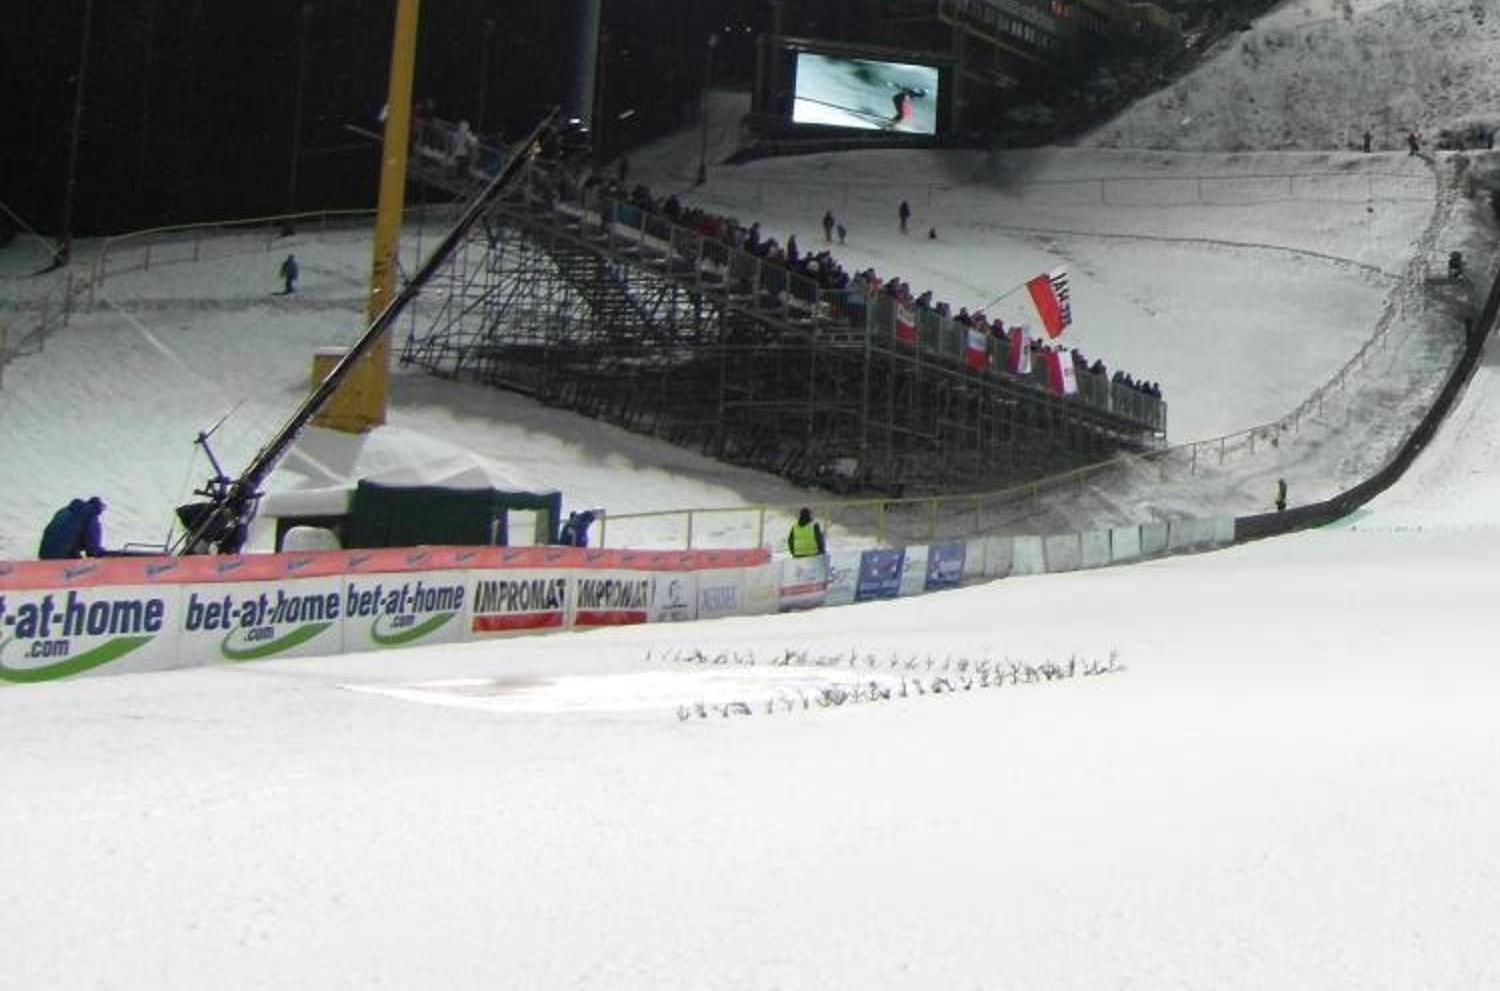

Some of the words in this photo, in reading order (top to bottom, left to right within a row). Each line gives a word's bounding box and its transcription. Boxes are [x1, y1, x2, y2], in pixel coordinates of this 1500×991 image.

[346, 581, 465, 618] bet-at-home
[474, 578, 566, 612] IMPROMAT
[185, 589, 339, 631] bet-at-home
[390, 614, 415, 628] .com
[243, 626, 275, 642] .com
[25, 639, 69, 658] .com
